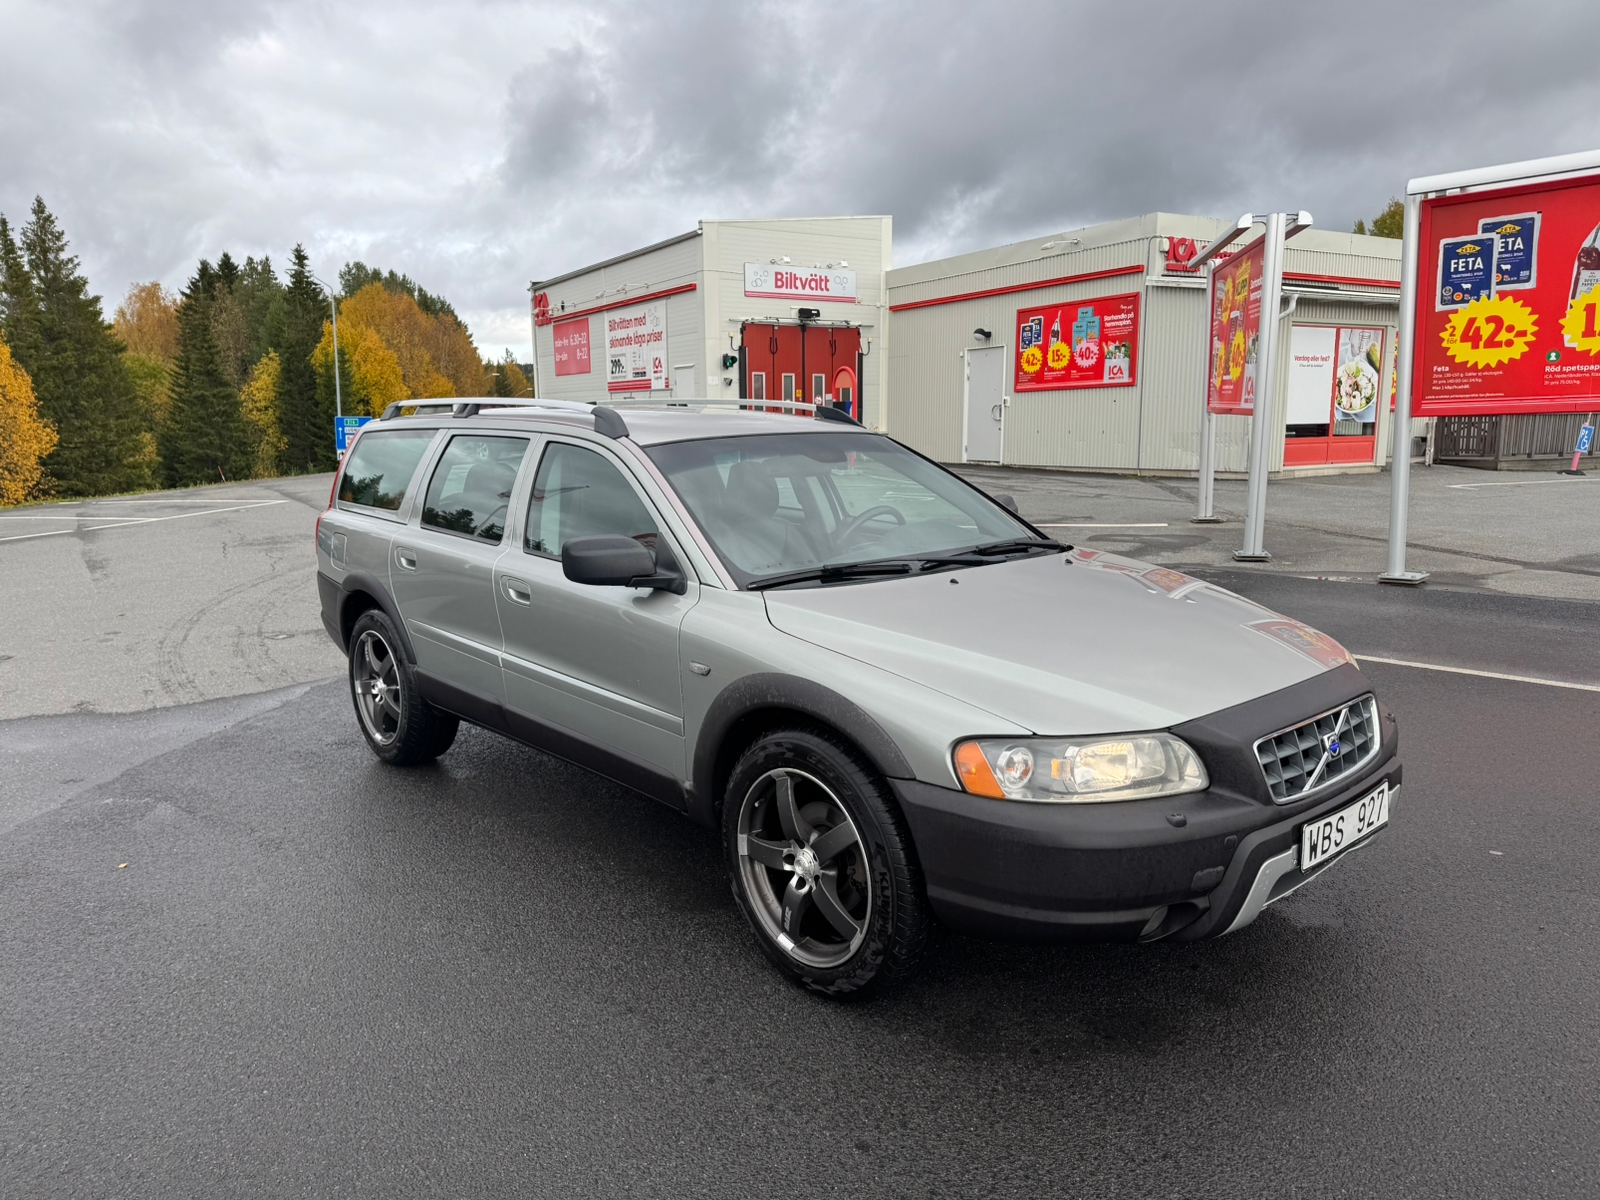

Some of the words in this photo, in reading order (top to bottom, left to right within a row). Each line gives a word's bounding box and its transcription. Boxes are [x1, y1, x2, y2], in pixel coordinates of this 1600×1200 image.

[1166, 236, 1198, 262] ICA
[1498, 236, 1524, 252] ETA
[1450, 256, 1484, 272] FETA
[774, 271, 830, 292] Biltvätt
[609, 318, 633, 332] Biltvätten
[634, 312, 646, 327] med
[610, 334, 632, 348] skinande
[633, 330, 646, 348] låga
[647, 328, 663, 346] priser
[1449, 326, 1456, 337] 2
[1460, 314, 1528, 350] 42:-
[1025, 353, 1040, 366] 42:-
[1052, 349, 1066, 363] 15:-
[1079, 347, 1098, 361] 40:-
[1109, 365, 1124, 376] ICA
[1562, 364, 1600, 373] spetspap
[1310, 815, 1344, 862] WBS
[1358, 788, 1384, 833] 927
